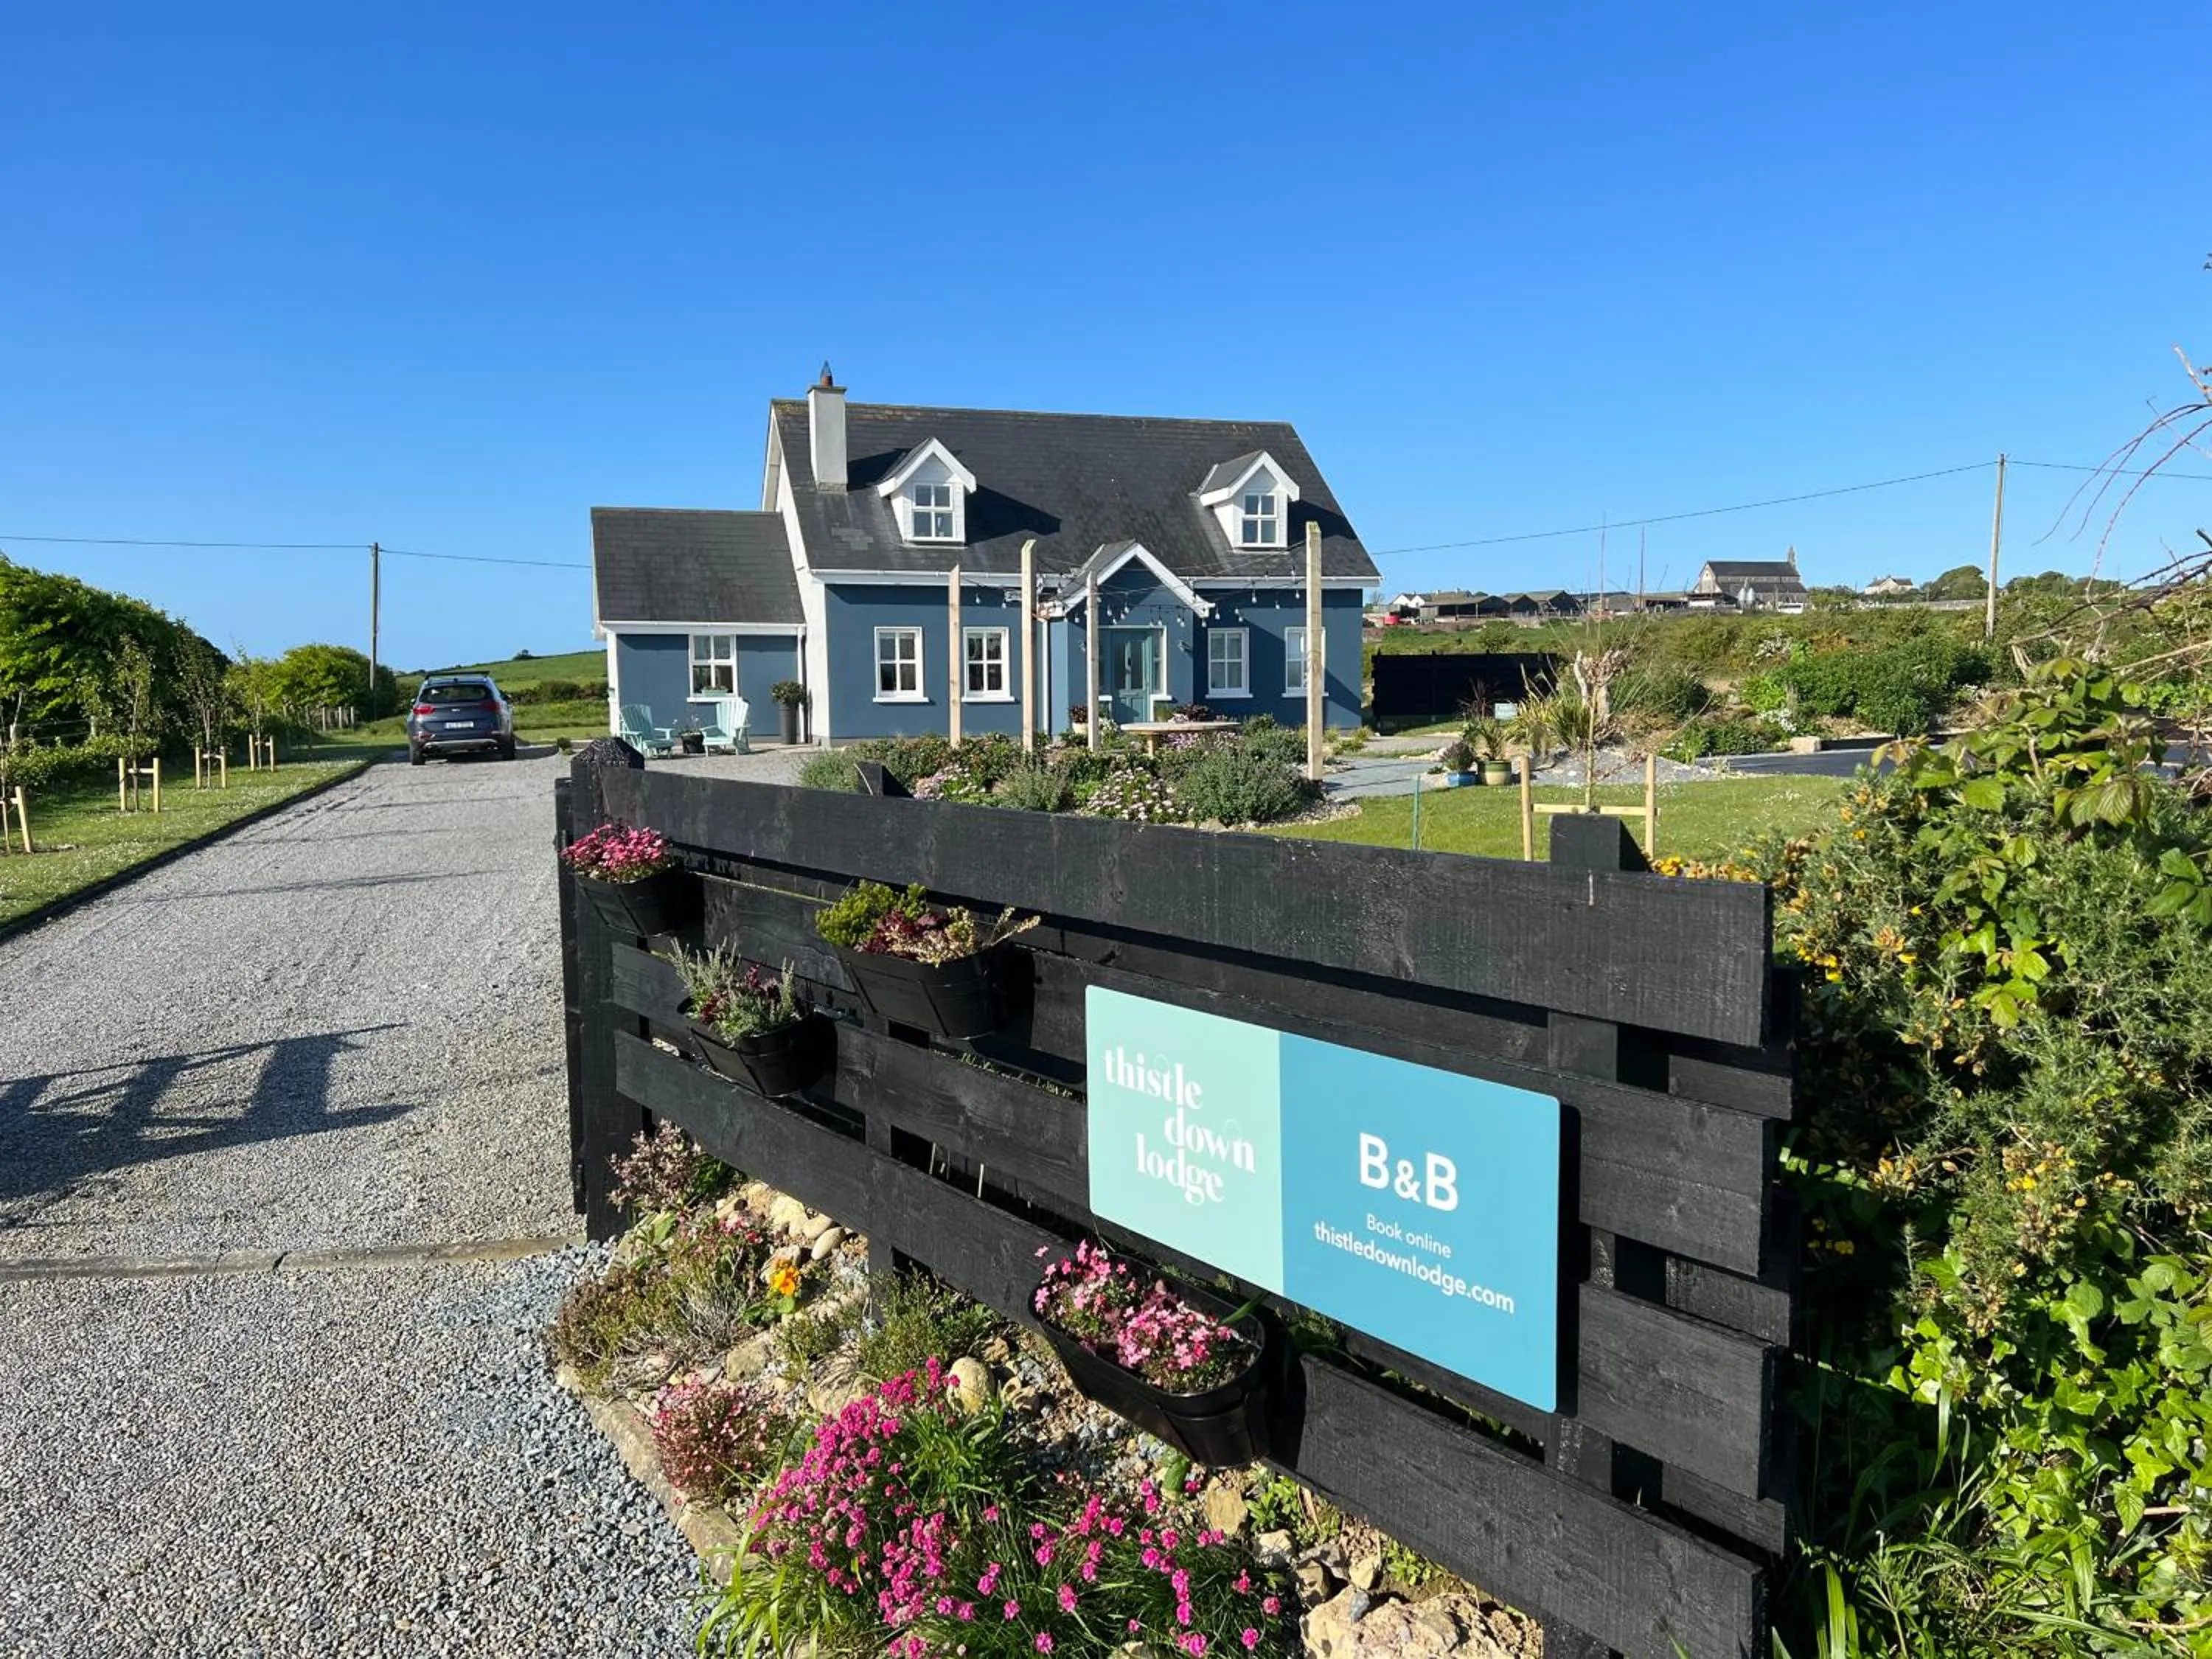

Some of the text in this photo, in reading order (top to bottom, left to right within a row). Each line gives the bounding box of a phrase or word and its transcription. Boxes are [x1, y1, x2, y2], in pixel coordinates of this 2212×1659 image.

[1104, 1046, 1203, 1110] thistle
[1136, 1132, 1225, 1206] lodge
[1164, 1106, 1256, 1174] down
[1359, 1132, 1458, 1211] B&B
[1314, 1221, 1515, 1314] thistledownlodge.com
[1366, 1213, 1452, 1259] Book online
